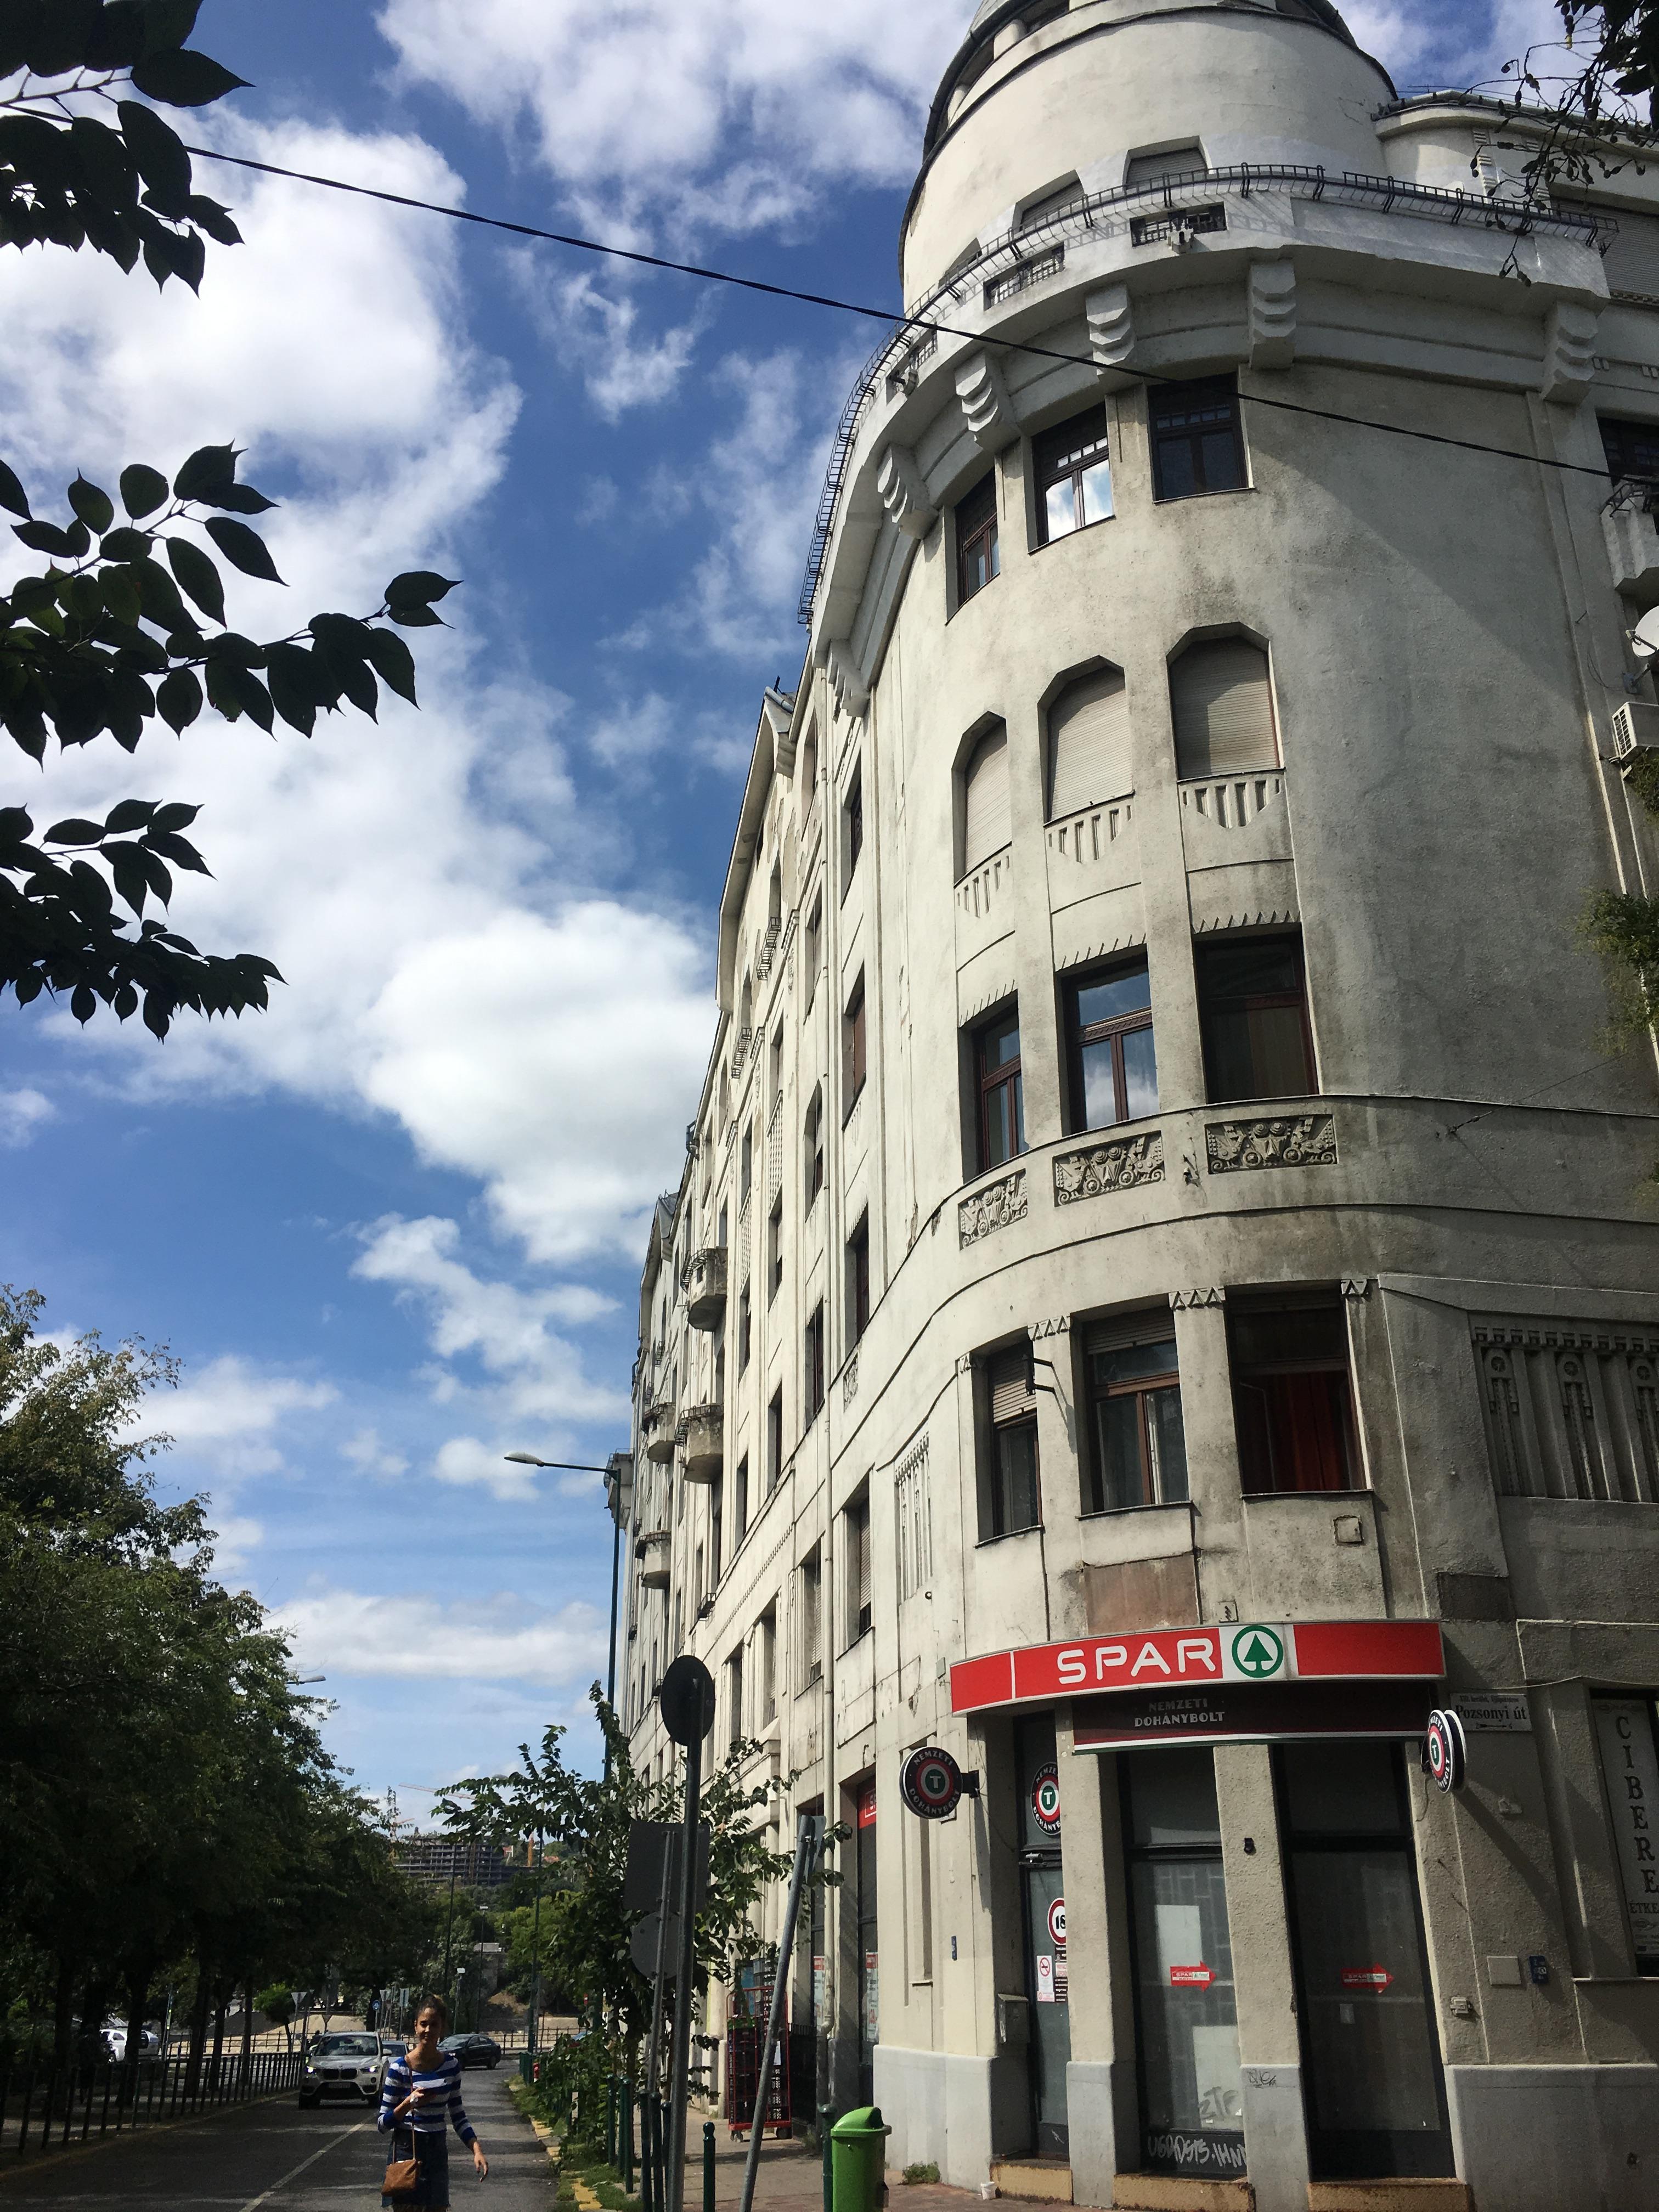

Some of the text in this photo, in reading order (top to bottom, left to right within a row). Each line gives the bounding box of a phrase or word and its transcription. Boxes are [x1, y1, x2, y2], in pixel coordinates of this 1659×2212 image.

[1057, 1638, 1216, 1684] SPAR
[1149, 1699, 1207, 1712] NEMZETI
[1135, 1712, 1225, 1727] DOHÁNYBOLT
[1455, 1705, 1527, 1722] Pozsonyi út
[913, 1751, 953, 1766] NEMZETI
[1432, 1745, 1437, 1759] T
[929, 1775, 941, 1788] T
[1036, 1767, 1057, 1784] NEMZE
[909, 1788, 960, 1814] DOHÁNYBOLT
[1043, 1792, 1053, 1805] T
[1615, 1716, 1659, 1893] CIBERE
[1033, 1806, 1061, 1831] DOHÁNYB
[1056, 1915, 1066, 1929] 18
